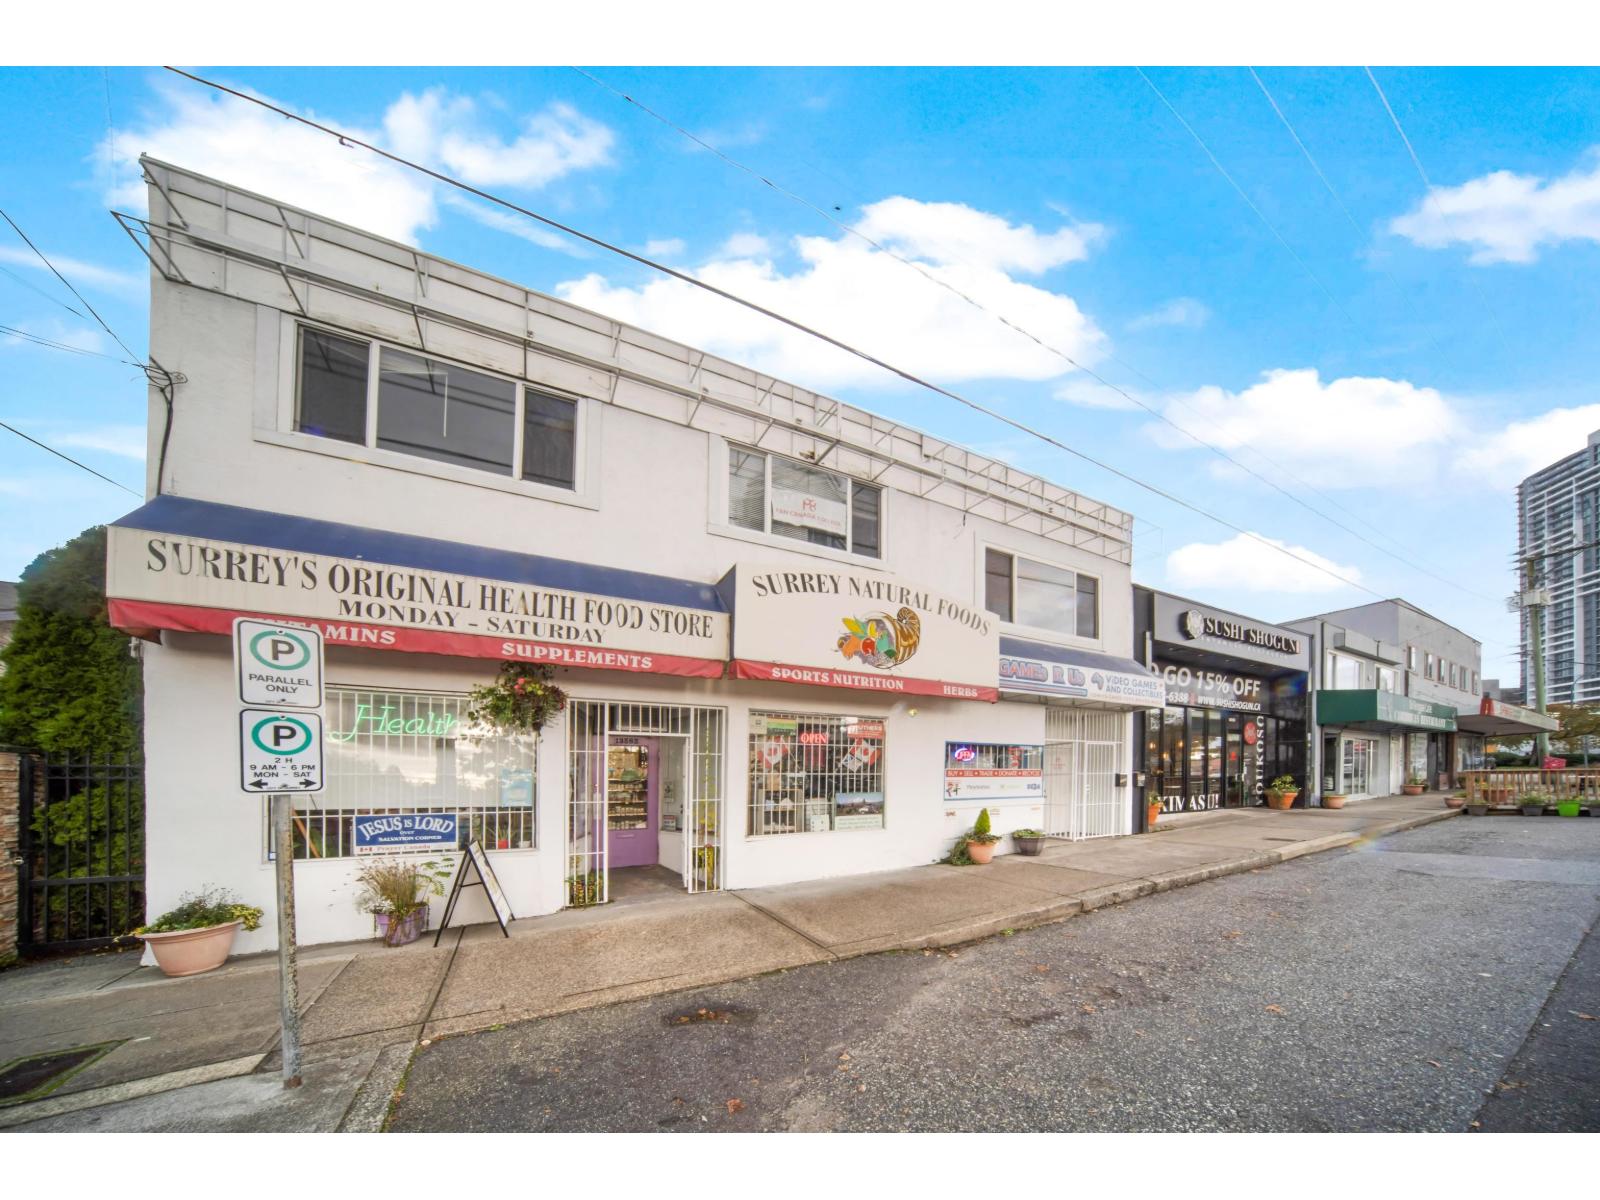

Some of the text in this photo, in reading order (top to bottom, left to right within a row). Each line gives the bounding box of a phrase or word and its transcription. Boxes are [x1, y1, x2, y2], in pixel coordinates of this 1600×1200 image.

[147, 538, 713, 639] SURREY'S ORIGINAL HEALTH FOOD STORE
[752, 572, 991, 637] SURREY NATURAL FOODS
[338, 599, 460, 627] MONDAY
[487, 617, 607, 643] SATURDAY
[1206, 618, 1245, 641] SUSHI
[1249, 628, 1300, 654] SHOGUN
[271, 638, 295, 661] P
[501, 643, 652, 669] SUPPLEMENTS
[249, 673, 312, 687] PARALLEL
[265, 684, 298, 694] ONLY
[772, 667, 904, 690] SPORTS NUTRITION
[943, 685, 978, 697] HERBS
[1164, 666, 1191, 687] GO
[1196, 671, 1229, 694] 15%
[1233, 677, 1261, 697] OFF
[273, 725, 297, 747] P
[329, 704, 459, 743] Health
[800, 732, 827, 743] OPEN
[358, 816, 454, 841] JESUS IS LORD
